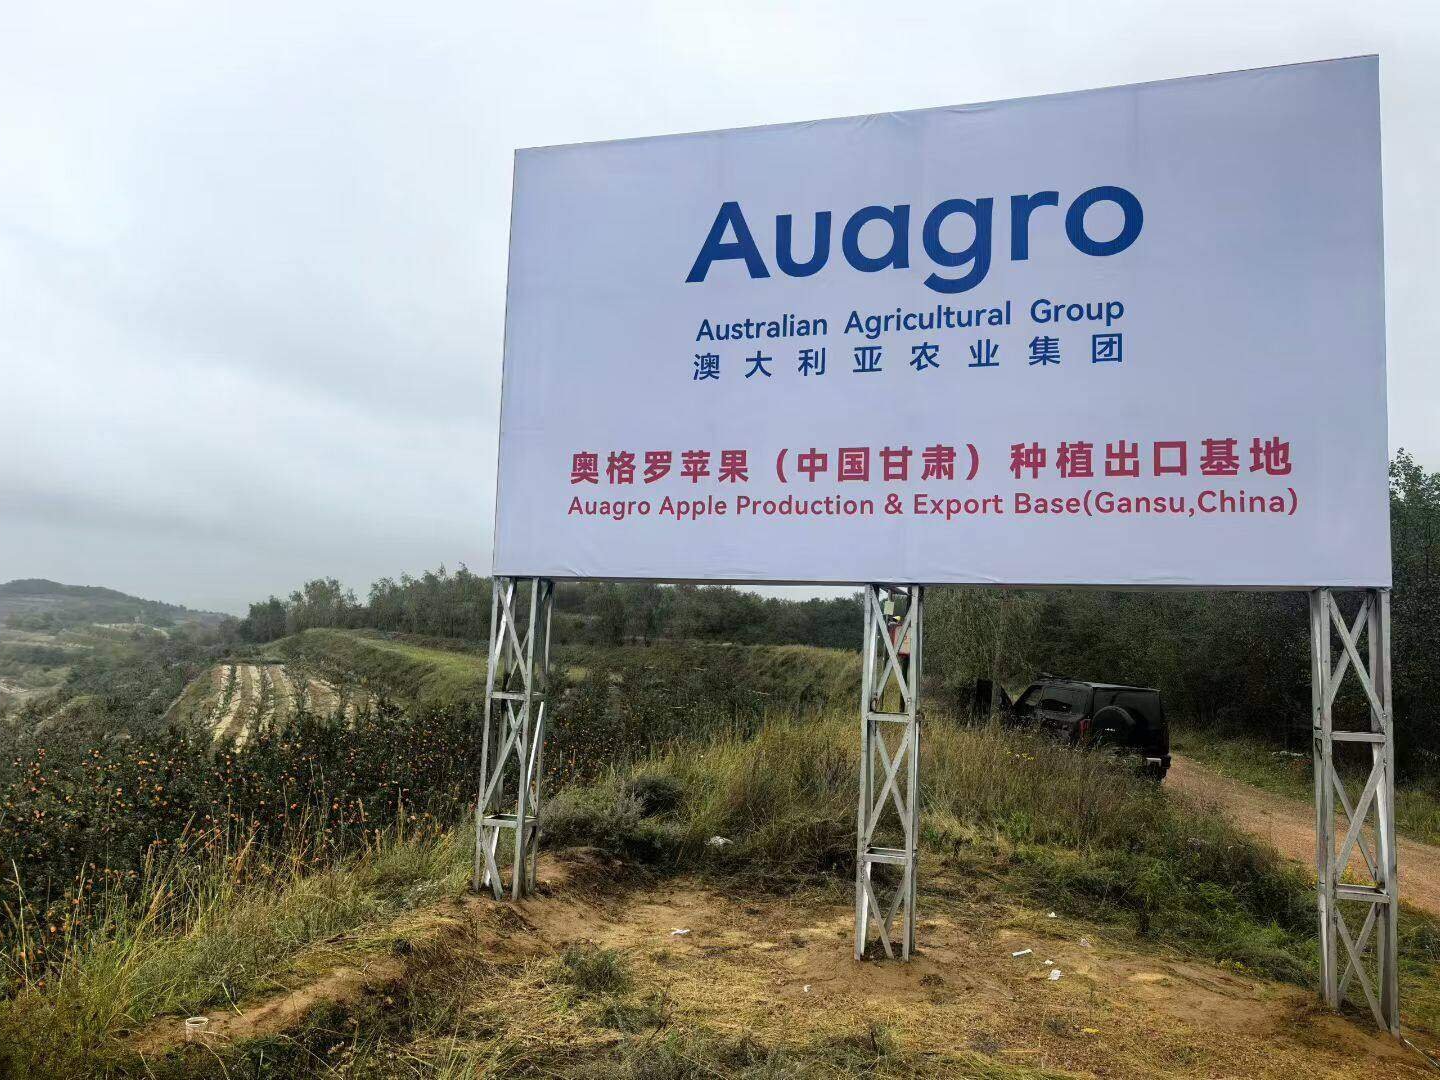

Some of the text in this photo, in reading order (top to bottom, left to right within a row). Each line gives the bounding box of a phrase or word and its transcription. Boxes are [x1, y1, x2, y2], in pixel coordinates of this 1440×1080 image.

[685, 185, 1144, 295] Auagro
[695, 298, 1125, 342] Australian Agricultural Group
[692, 332, 1124, 382] 澳大利亚农业集团
[567, 487, 1299, 521] Auagro Apple Production & Export Base(Gansu,China)
